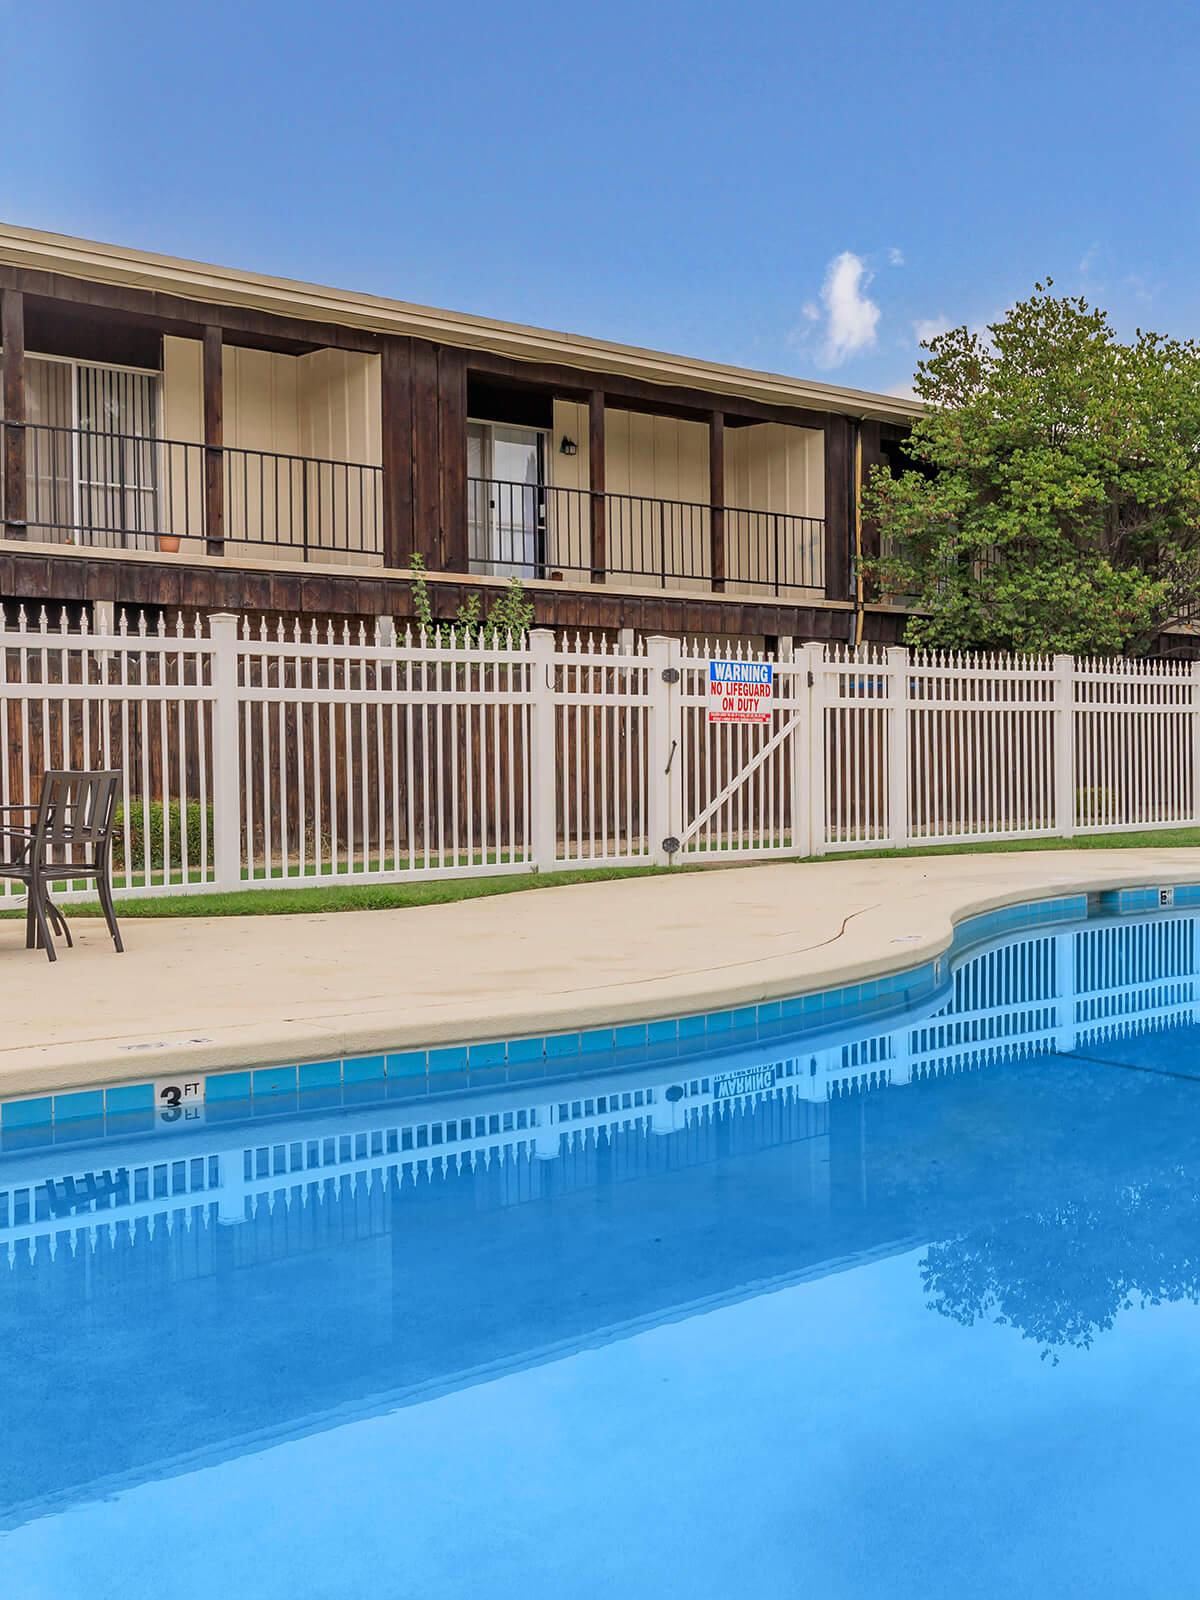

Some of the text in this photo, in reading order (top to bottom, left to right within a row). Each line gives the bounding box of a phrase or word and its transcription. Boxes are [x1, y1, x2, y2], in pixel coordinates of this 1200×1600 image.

[714, 663, 769, 683] WARNING
[711, 682, 771, 697] NO LIFEGUARD
[722, 697, 760, 712] ON DUTY
[160, 1082, 200, 1107] 3 FT
